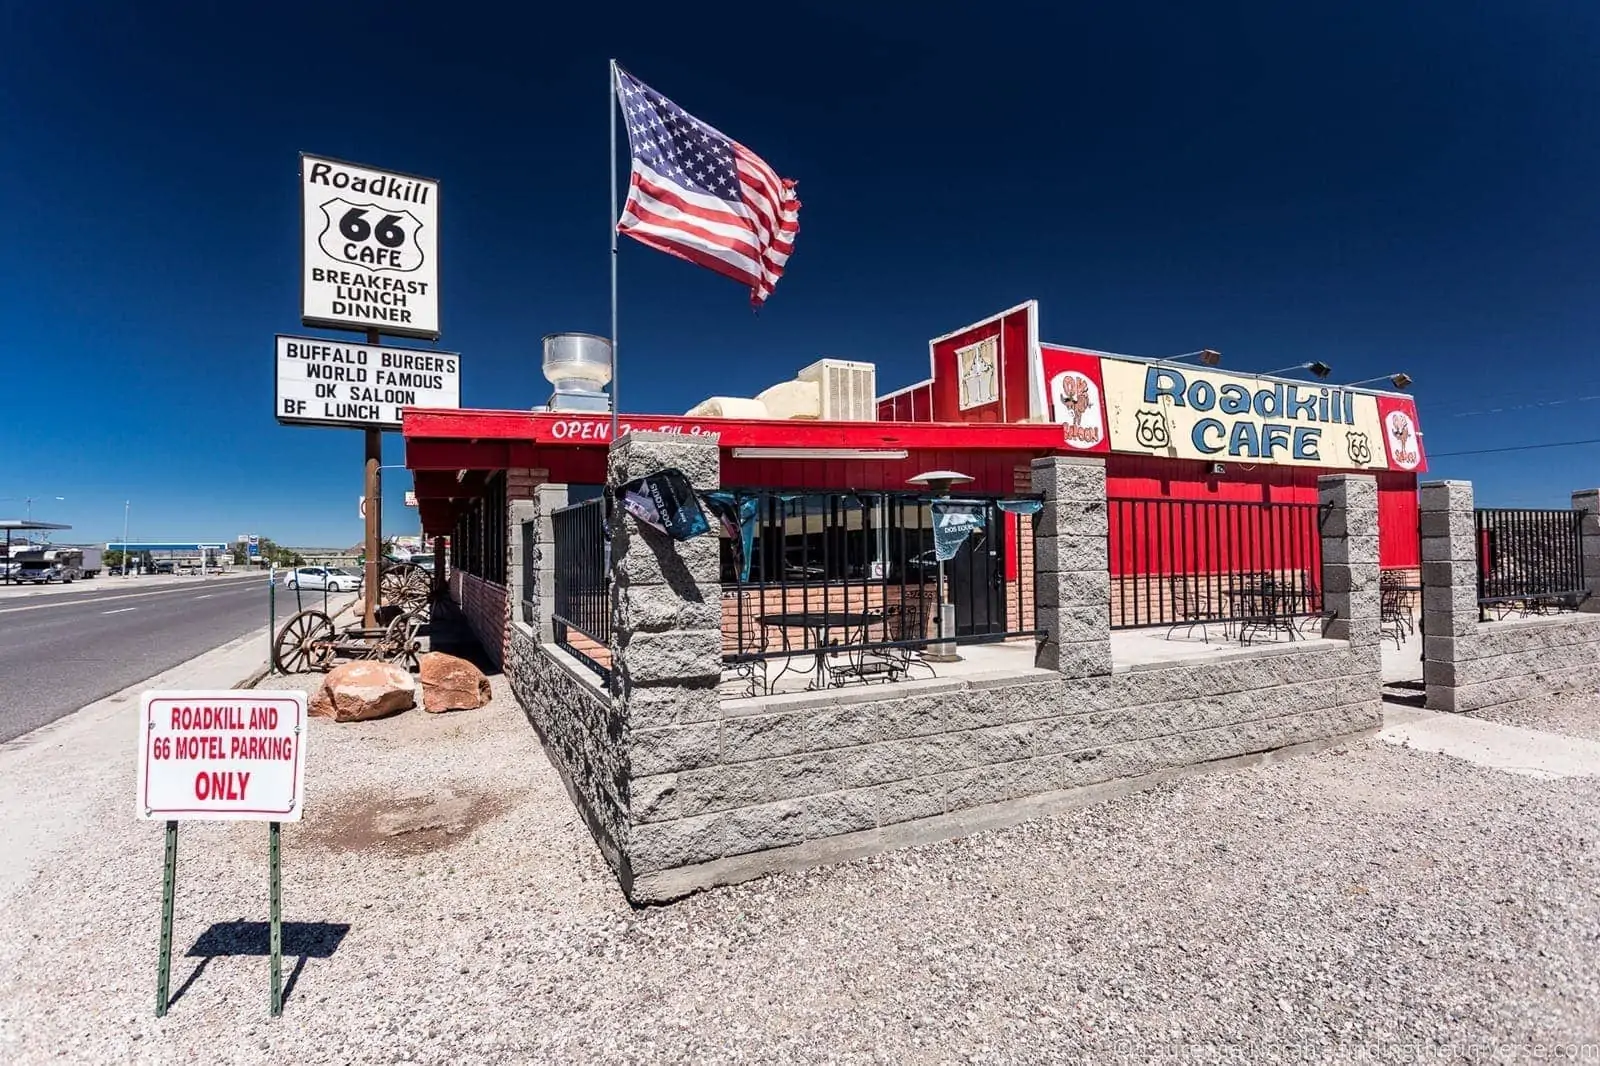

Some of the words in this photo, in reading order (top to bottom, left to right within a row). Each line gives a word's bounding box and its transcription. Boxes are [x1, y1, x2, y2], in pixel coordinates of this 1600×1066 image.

[310, 163, 429, 205] Roadkill
[339, 208, 405, 248] 66
[344, 244, 402, 268] CAFE
[312, 268, 429, 296] BREAKFAST
[337, 286, 407, 307] LUNCH
[332, 301, 412, 323] DINNER
[287, 343, 367, 365] BUFFALO
[381, 353, 456, 374] BURGERS
[306, 363, 367, 383] WORLD
[376, 370, 443, 389] FAMOUS
[315, 383, 337, 398] OK
[350, 386, 416, 405] SALOON
[1143, 366, 1355, 426] Roadkill
[284, 399, 307, 415] BF
[324, 403, 380, 419] LUNCH
[552, 421, 610, 439] OPEN
[1141, 420, 1166, 442] 66
[1191, 418, 1322, 461] CAFE
[1351, 440, 1371, 458] 66
[651, 482, 664, 509] EQUIS
[659, 508, 673, 529] DOS
[171, 707, 244, 730] ROADKILL
[250, 707, 278, 730] AND
[153, 737, 170, 760] 66
[176, 737, 225, 760] MOTEL
[231, 737, 292, 761] PARKING
[195, 771, 250, 800] ONLY
